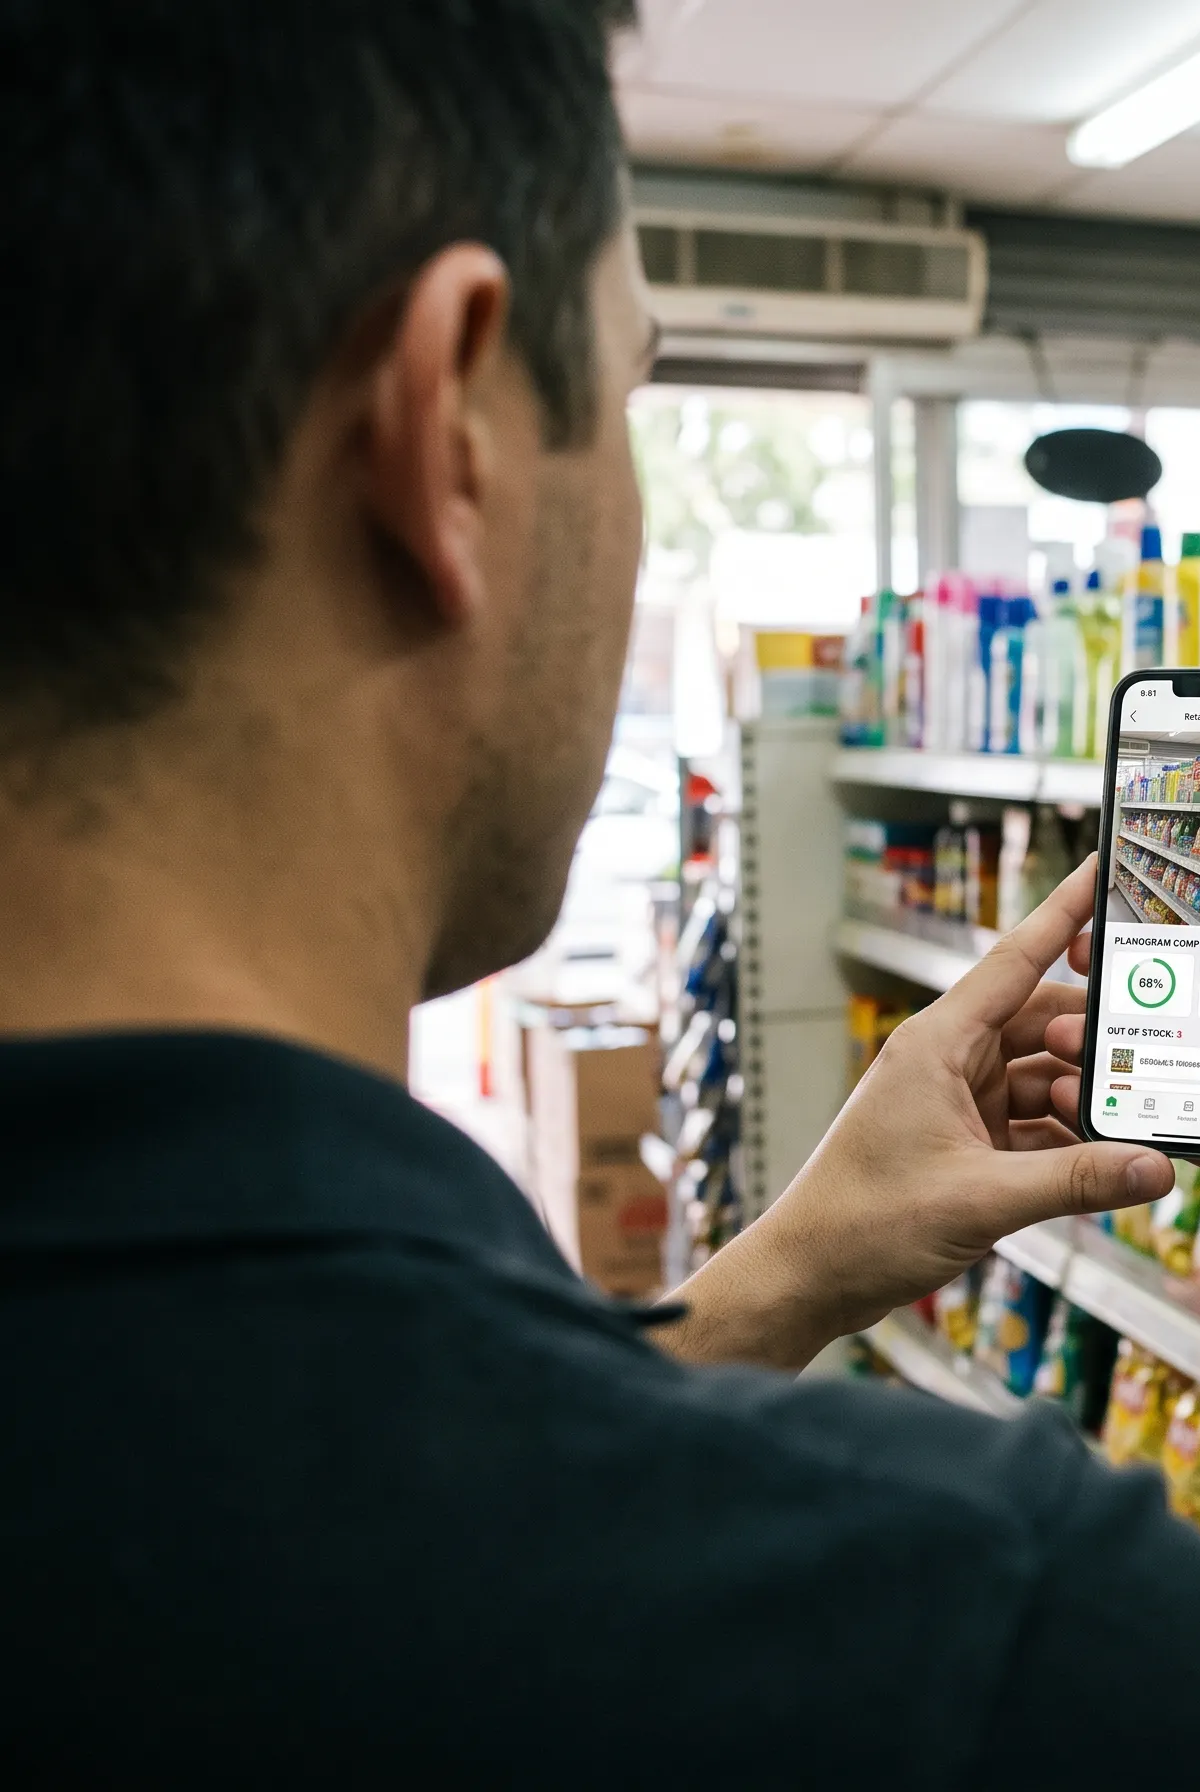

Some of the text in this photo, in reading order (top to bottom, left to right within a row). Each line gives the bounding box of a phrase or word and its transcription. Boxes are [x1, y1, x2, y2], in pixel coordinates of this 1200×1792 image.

[1114, 936, 1171, 947] PLANOGRAM
[1138, 978, 1164, 989] 68%
[1107, 1026, 1182, 1039] OUT OF STOCK: 3
